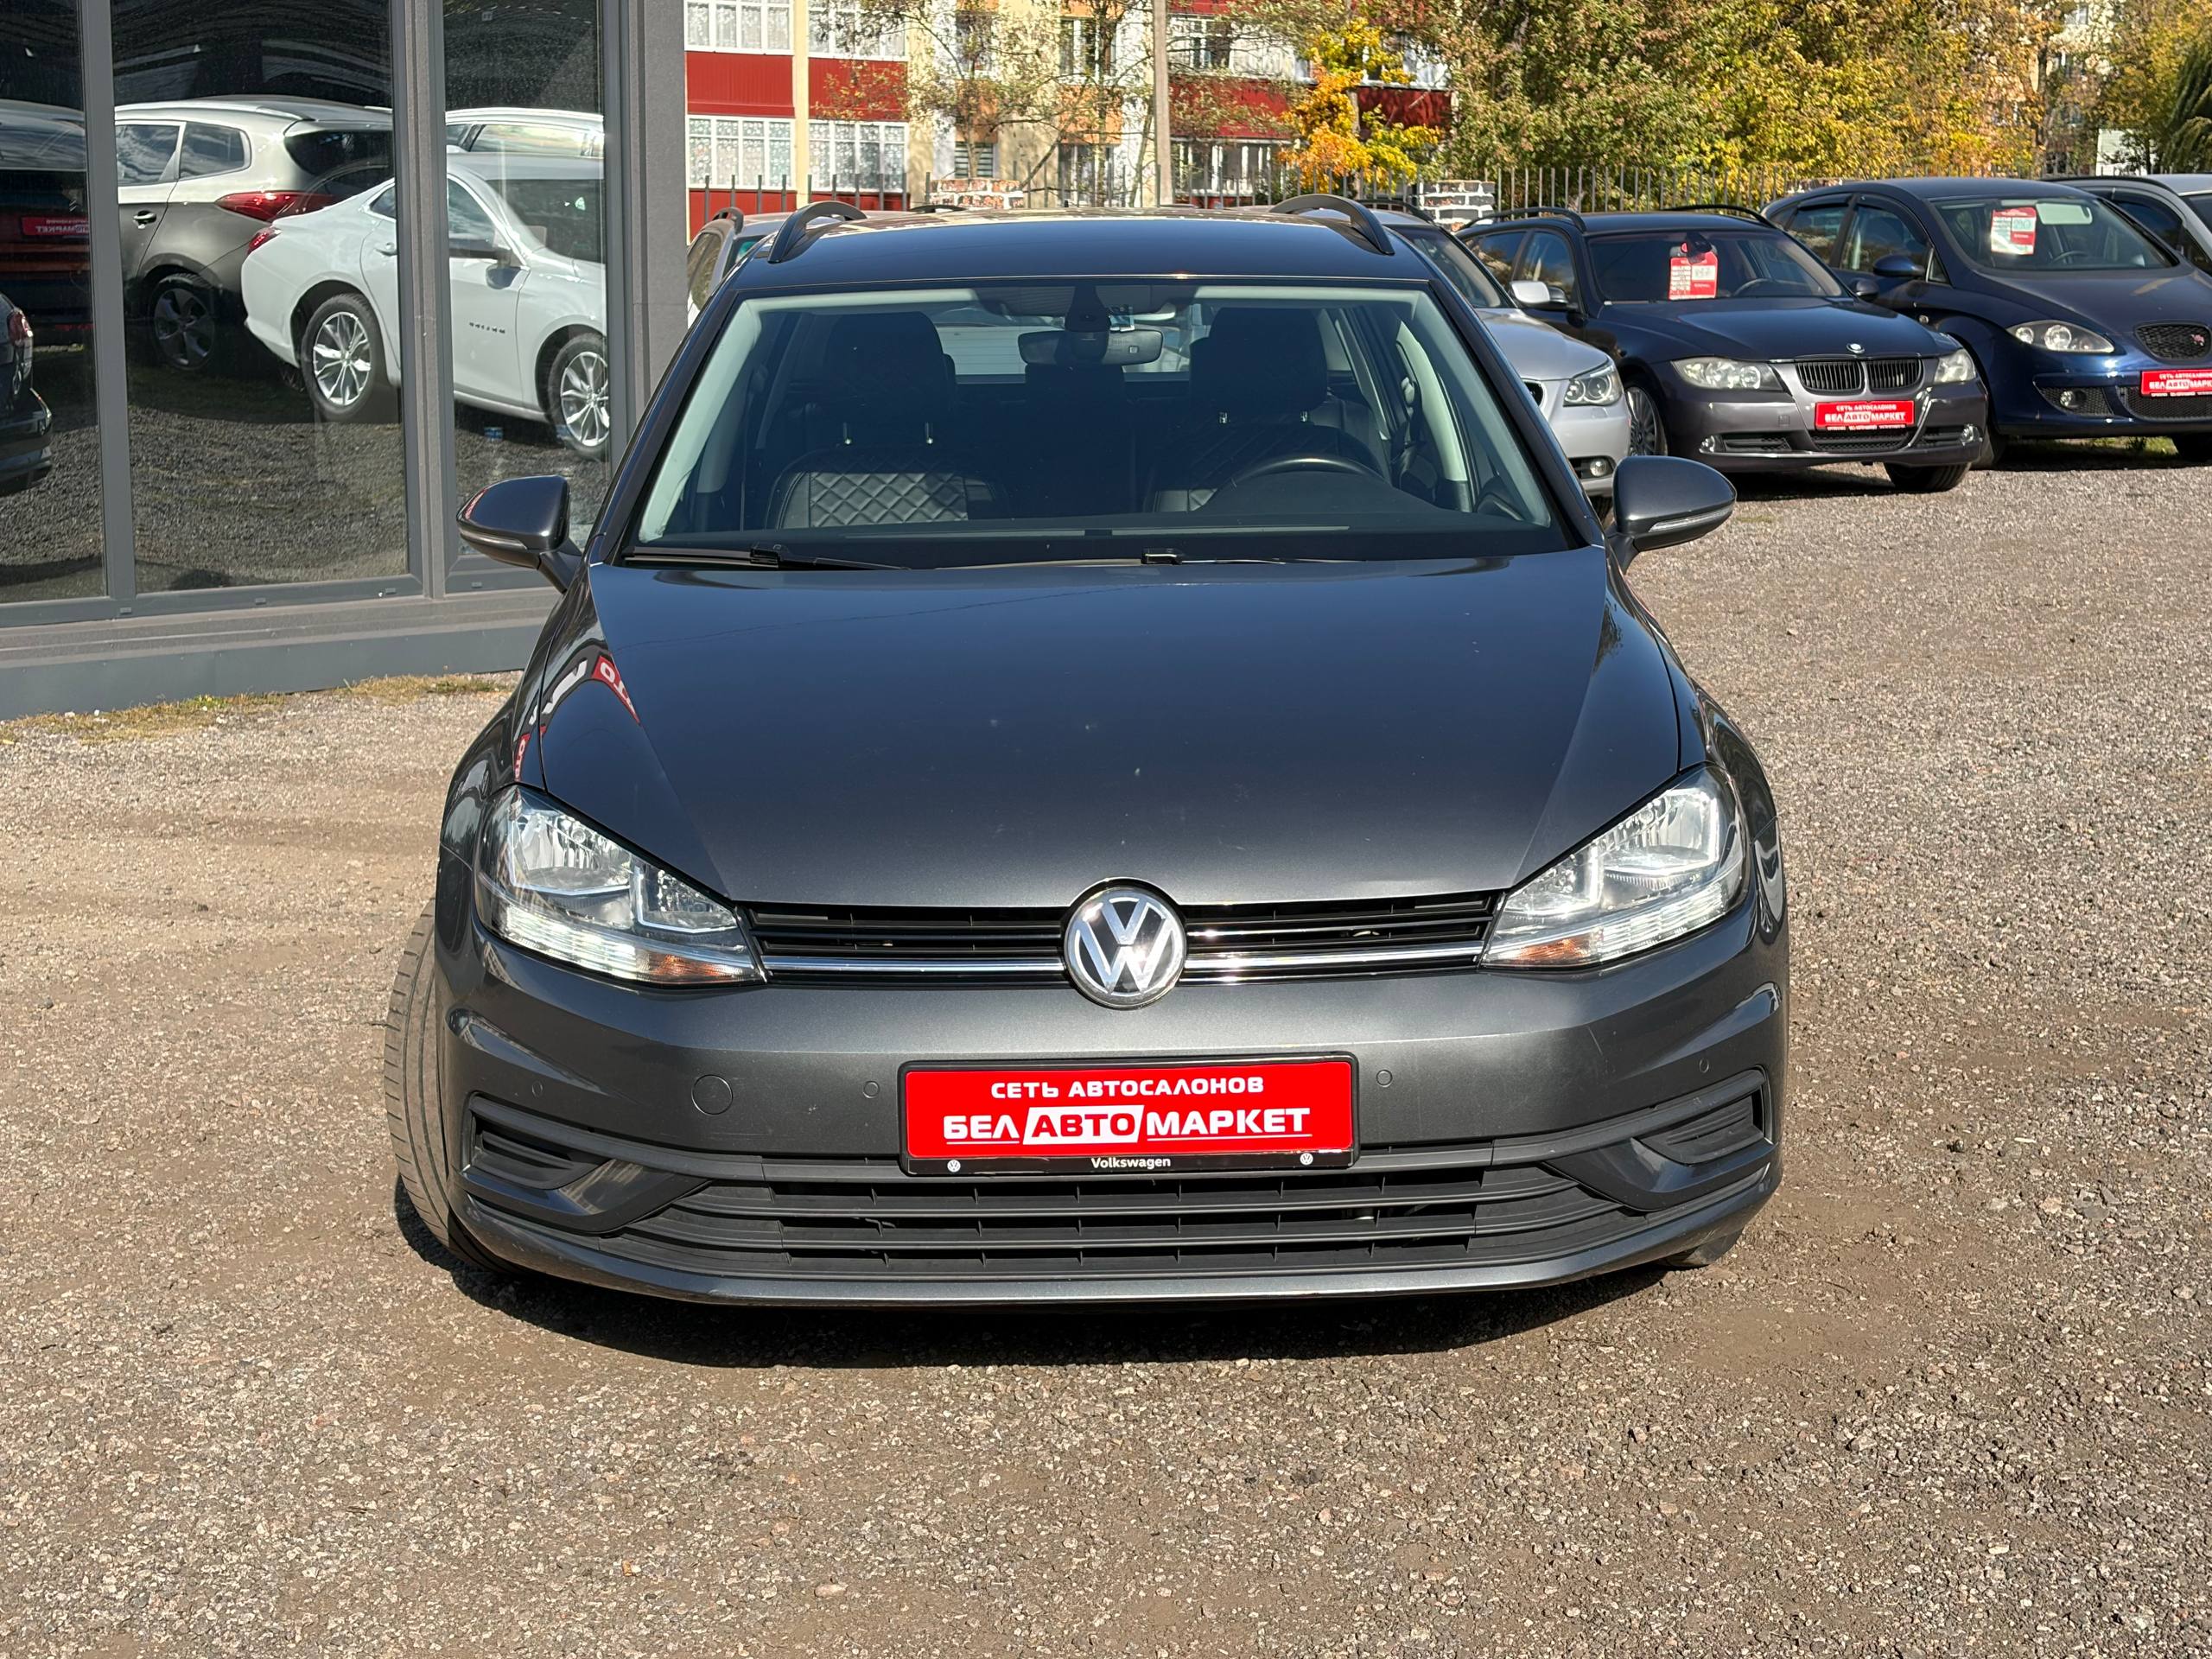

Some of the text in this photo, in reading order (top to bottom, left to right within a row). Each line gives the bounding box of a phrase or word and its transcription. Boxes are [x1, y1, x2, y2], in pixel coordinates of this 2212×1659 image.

[991, 1077, 1264, 1099] СЕТЬ АВТОСАЛОНОВ
[1090, 1156, 1171, 1170] Volkswagen
